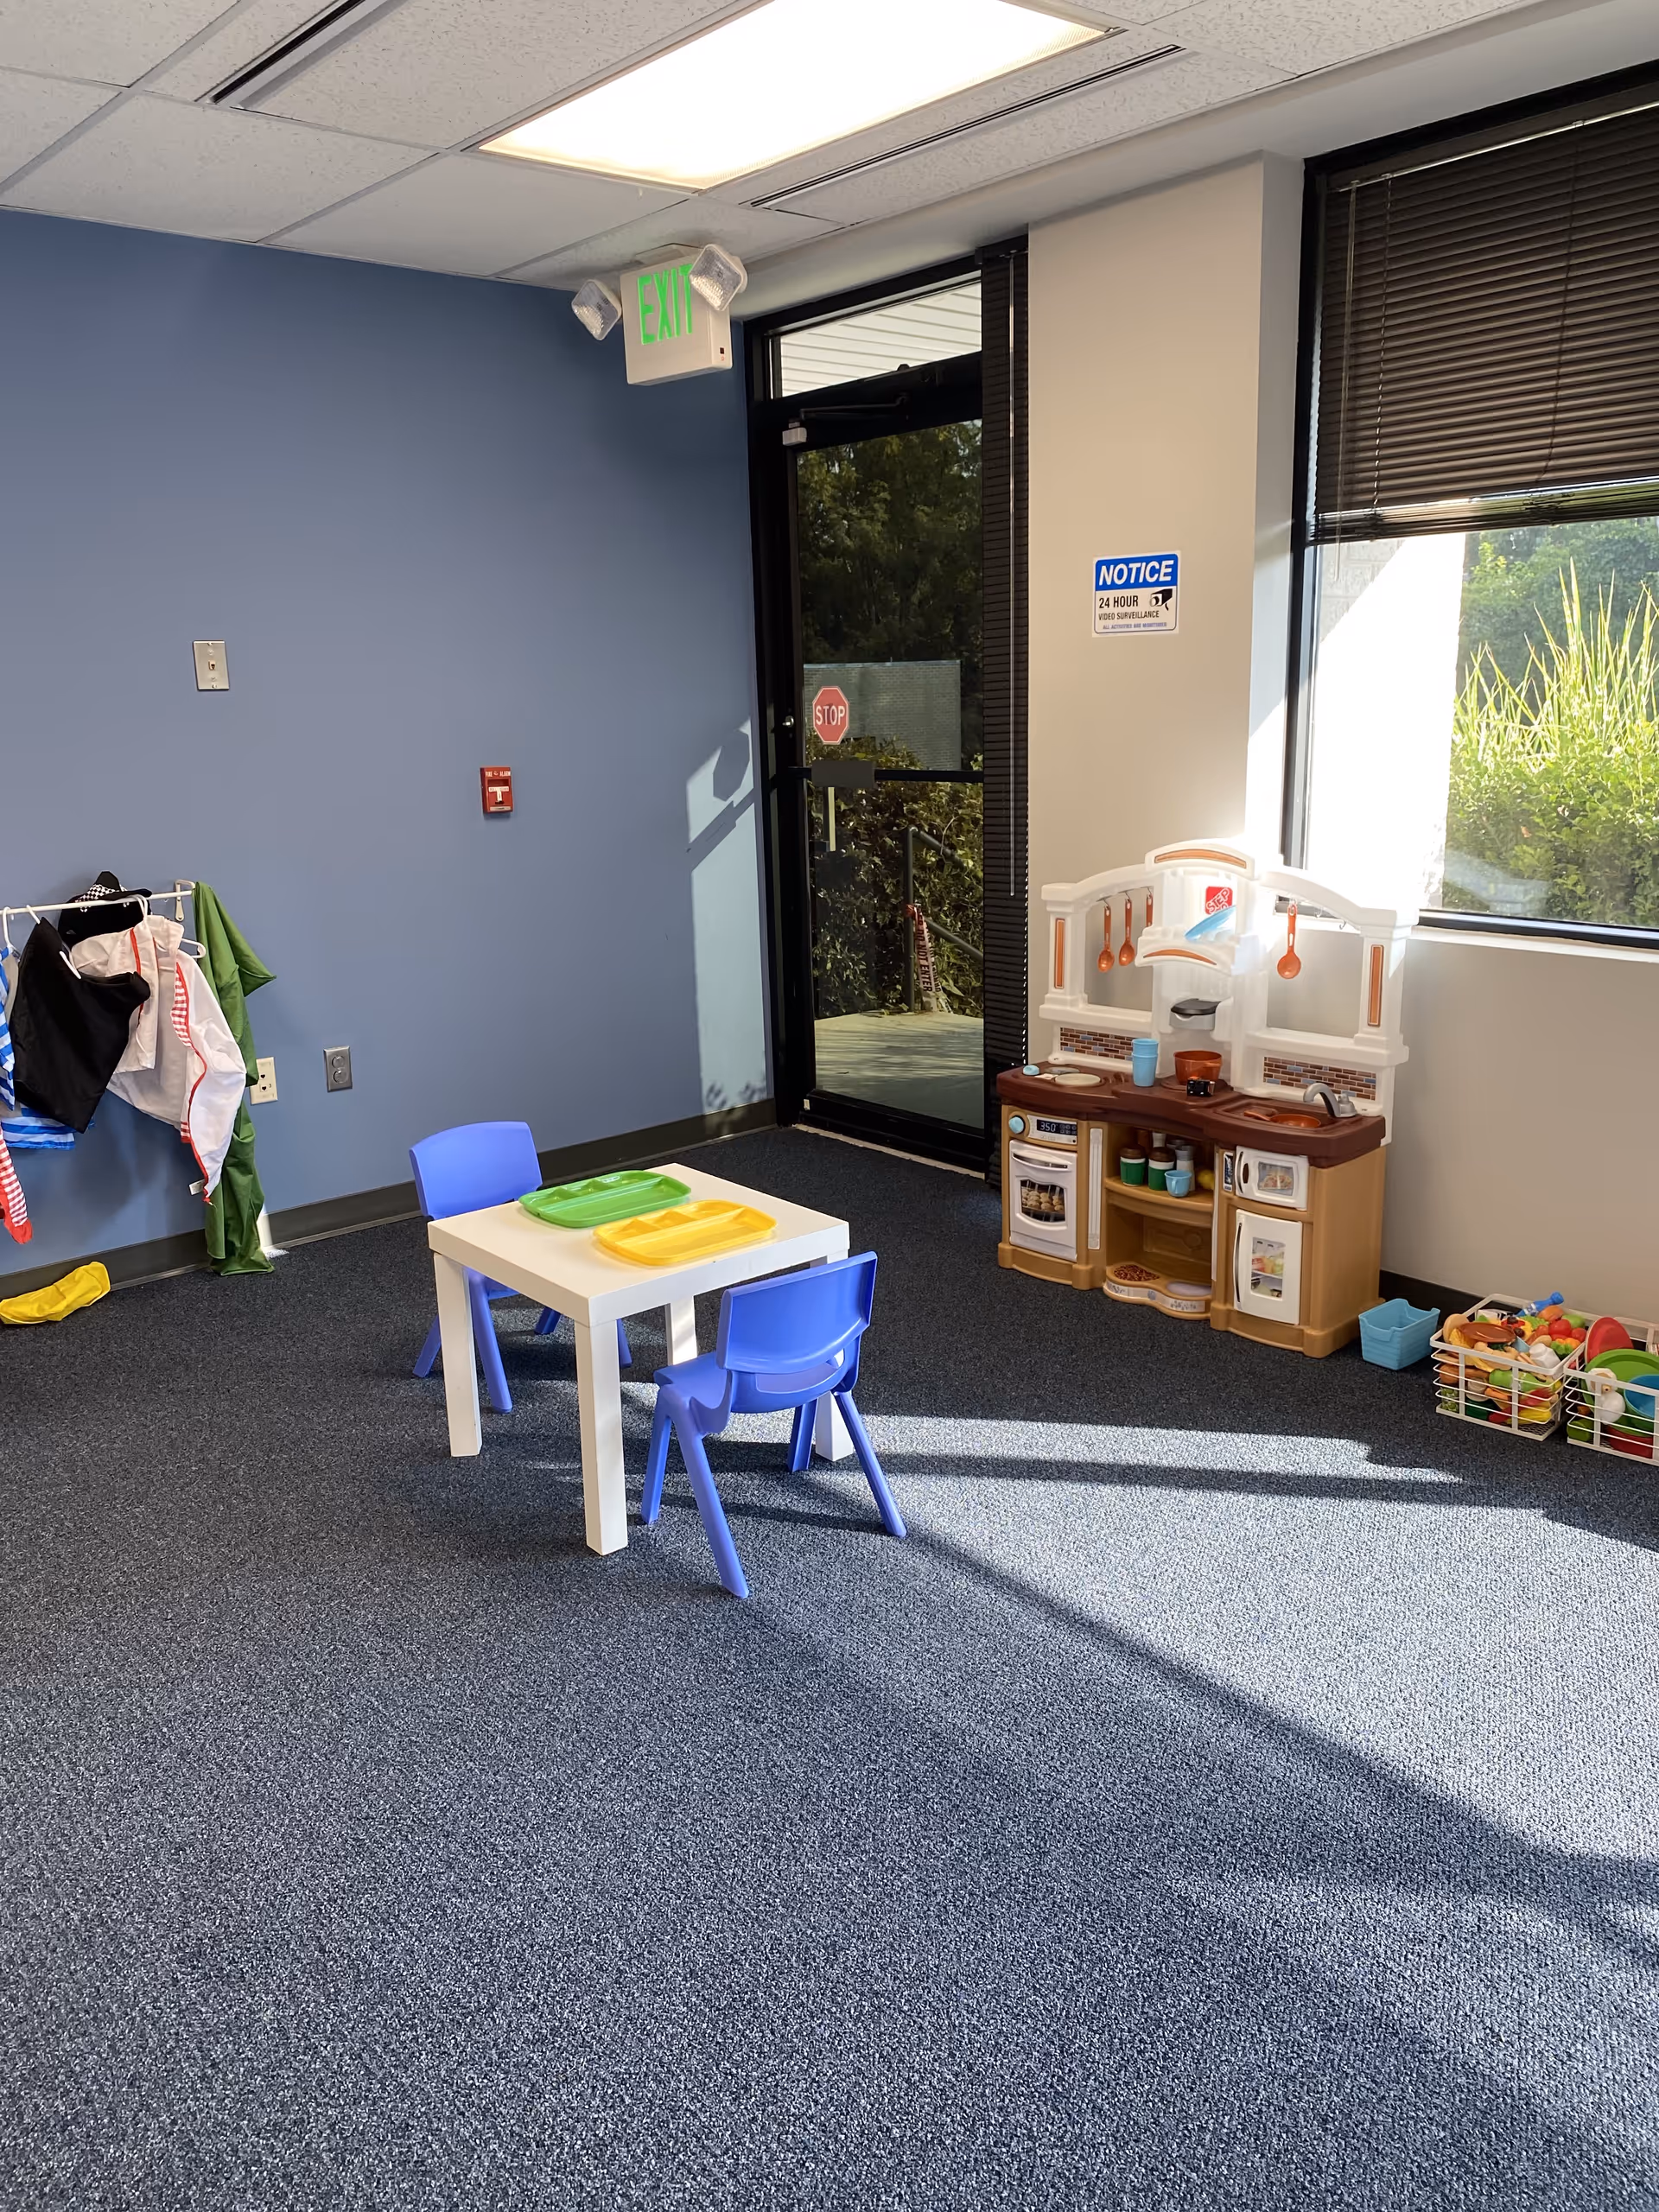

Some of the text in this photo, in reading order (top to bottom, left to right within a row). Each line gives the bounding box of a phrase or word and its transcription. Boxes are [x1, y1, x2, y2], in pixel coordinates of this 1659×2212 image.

[638, 264, 694, 346] EXIT
[1098, 560, 1174, 586] NOTICE
[1098, 595, 1139, 609] 24 HOUR
[1098, 610, 1160, 620] VIDEO SURVEILLANCE
[815, 705, 846, 726] STOP
[1205, 887, 1230, 914] STEP
[917, 944, 929, 963] NOT
[920, 963, 933, 992] ENTER
